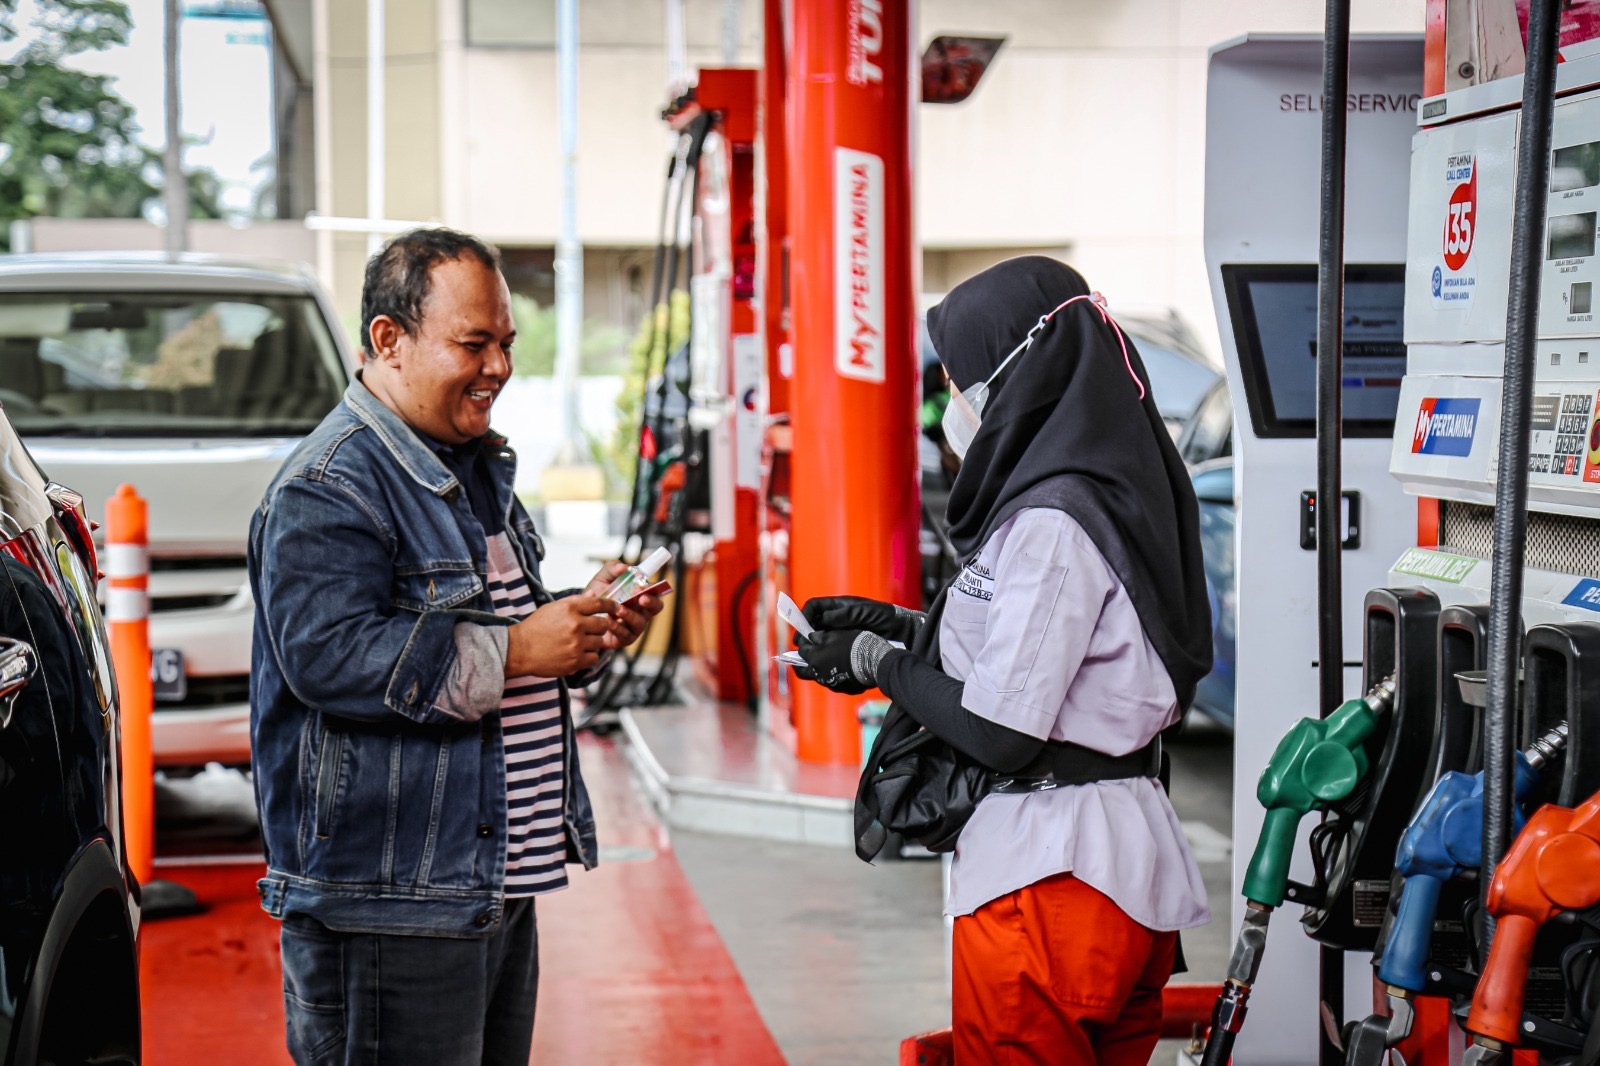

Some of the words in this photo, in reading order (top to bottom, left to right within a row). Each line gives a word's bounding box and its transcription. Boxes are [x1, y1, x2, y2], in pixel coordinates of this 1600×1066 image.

[1447, 156, 1472, 168] PERTAMINA
[1446, 170, 1456, 181] CALL
[1456, 168, 1471, 179] CENTER
[1444, 201, 1472, 256] 135
[1398, 551, 1453, 579] PERTAMINA
[1446, 558, 1476, 581] DEX
